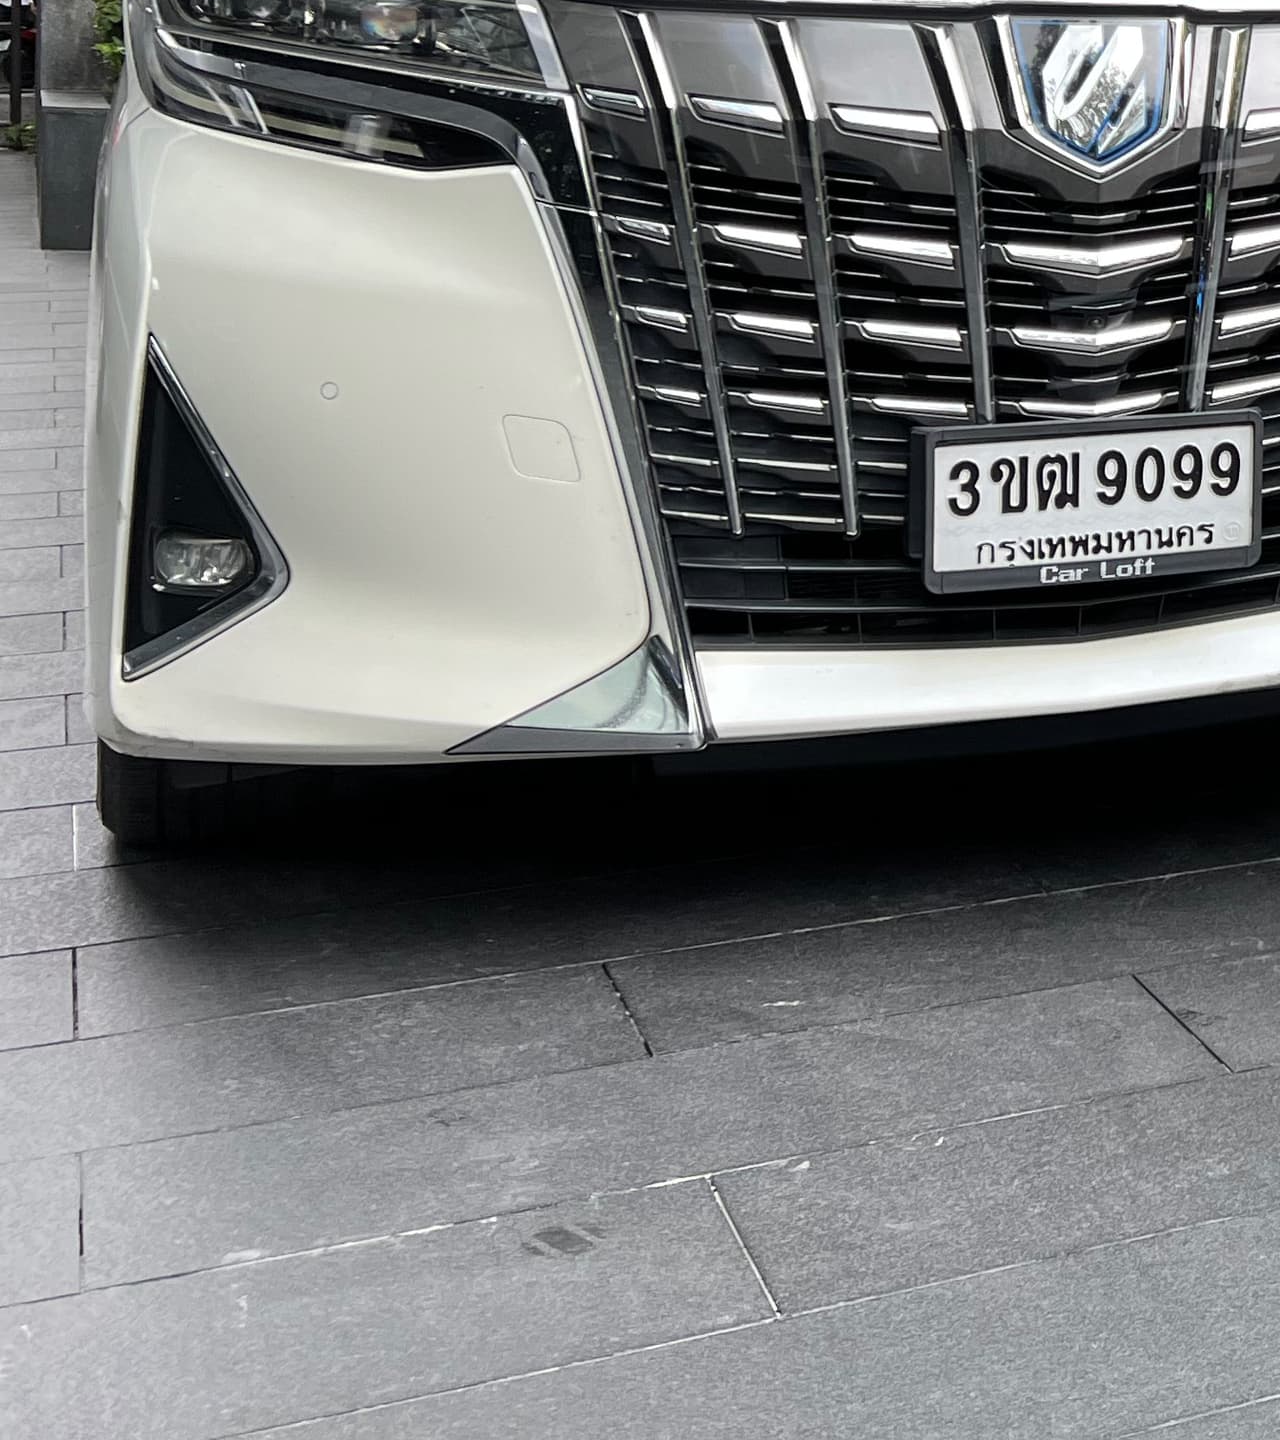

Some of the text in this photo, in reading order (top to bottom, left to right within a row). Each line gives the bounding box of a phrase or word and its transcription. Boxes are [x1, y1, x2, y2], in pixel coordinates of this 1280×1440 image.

[1096, 441, 1242, 506] 9099
[1040, 557, 1155, 584] Car Loft
